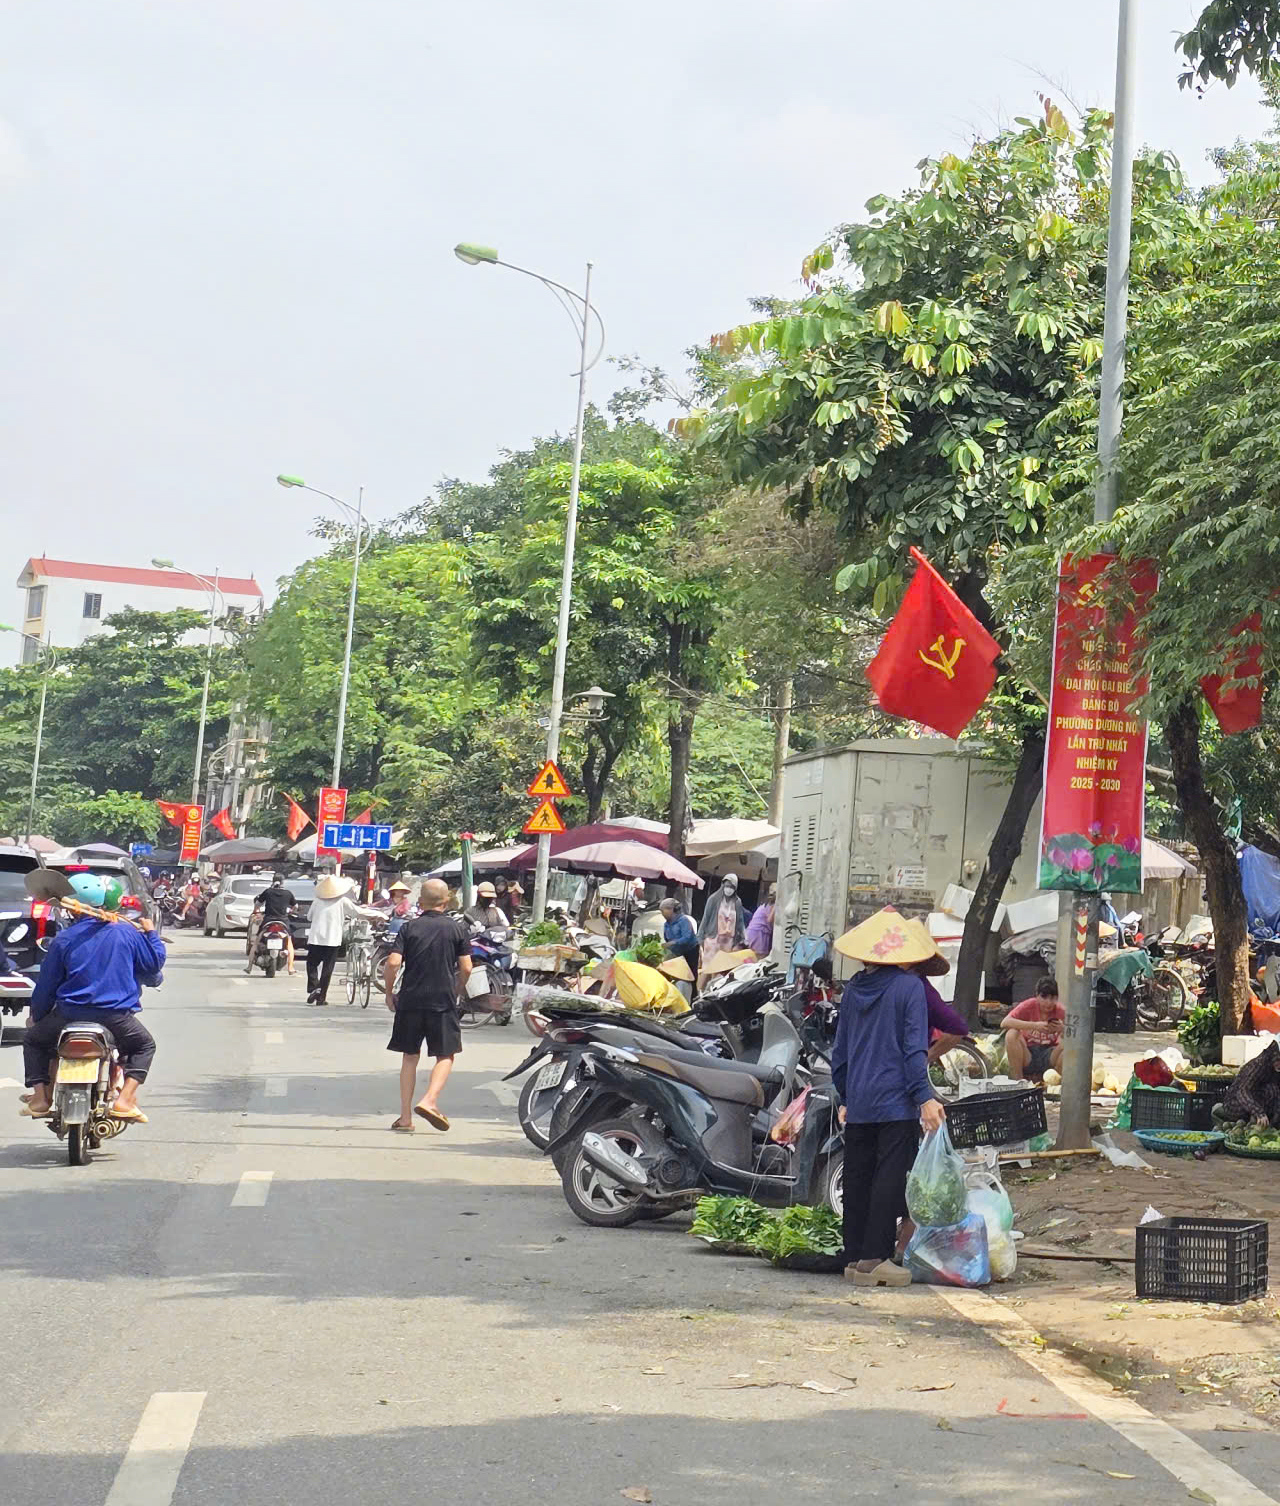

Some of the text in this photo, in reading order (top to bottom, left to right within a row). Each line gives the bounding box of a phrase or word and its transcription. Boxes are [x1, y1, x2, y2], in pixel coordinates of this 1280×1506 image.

[1125, 719, 1138, 736] NỘ
[1076, 755, 1104, 772] NHIỆM
[1070, 777, 1093, 790] 2025
[1101, 778, 1121, 791] 2030
